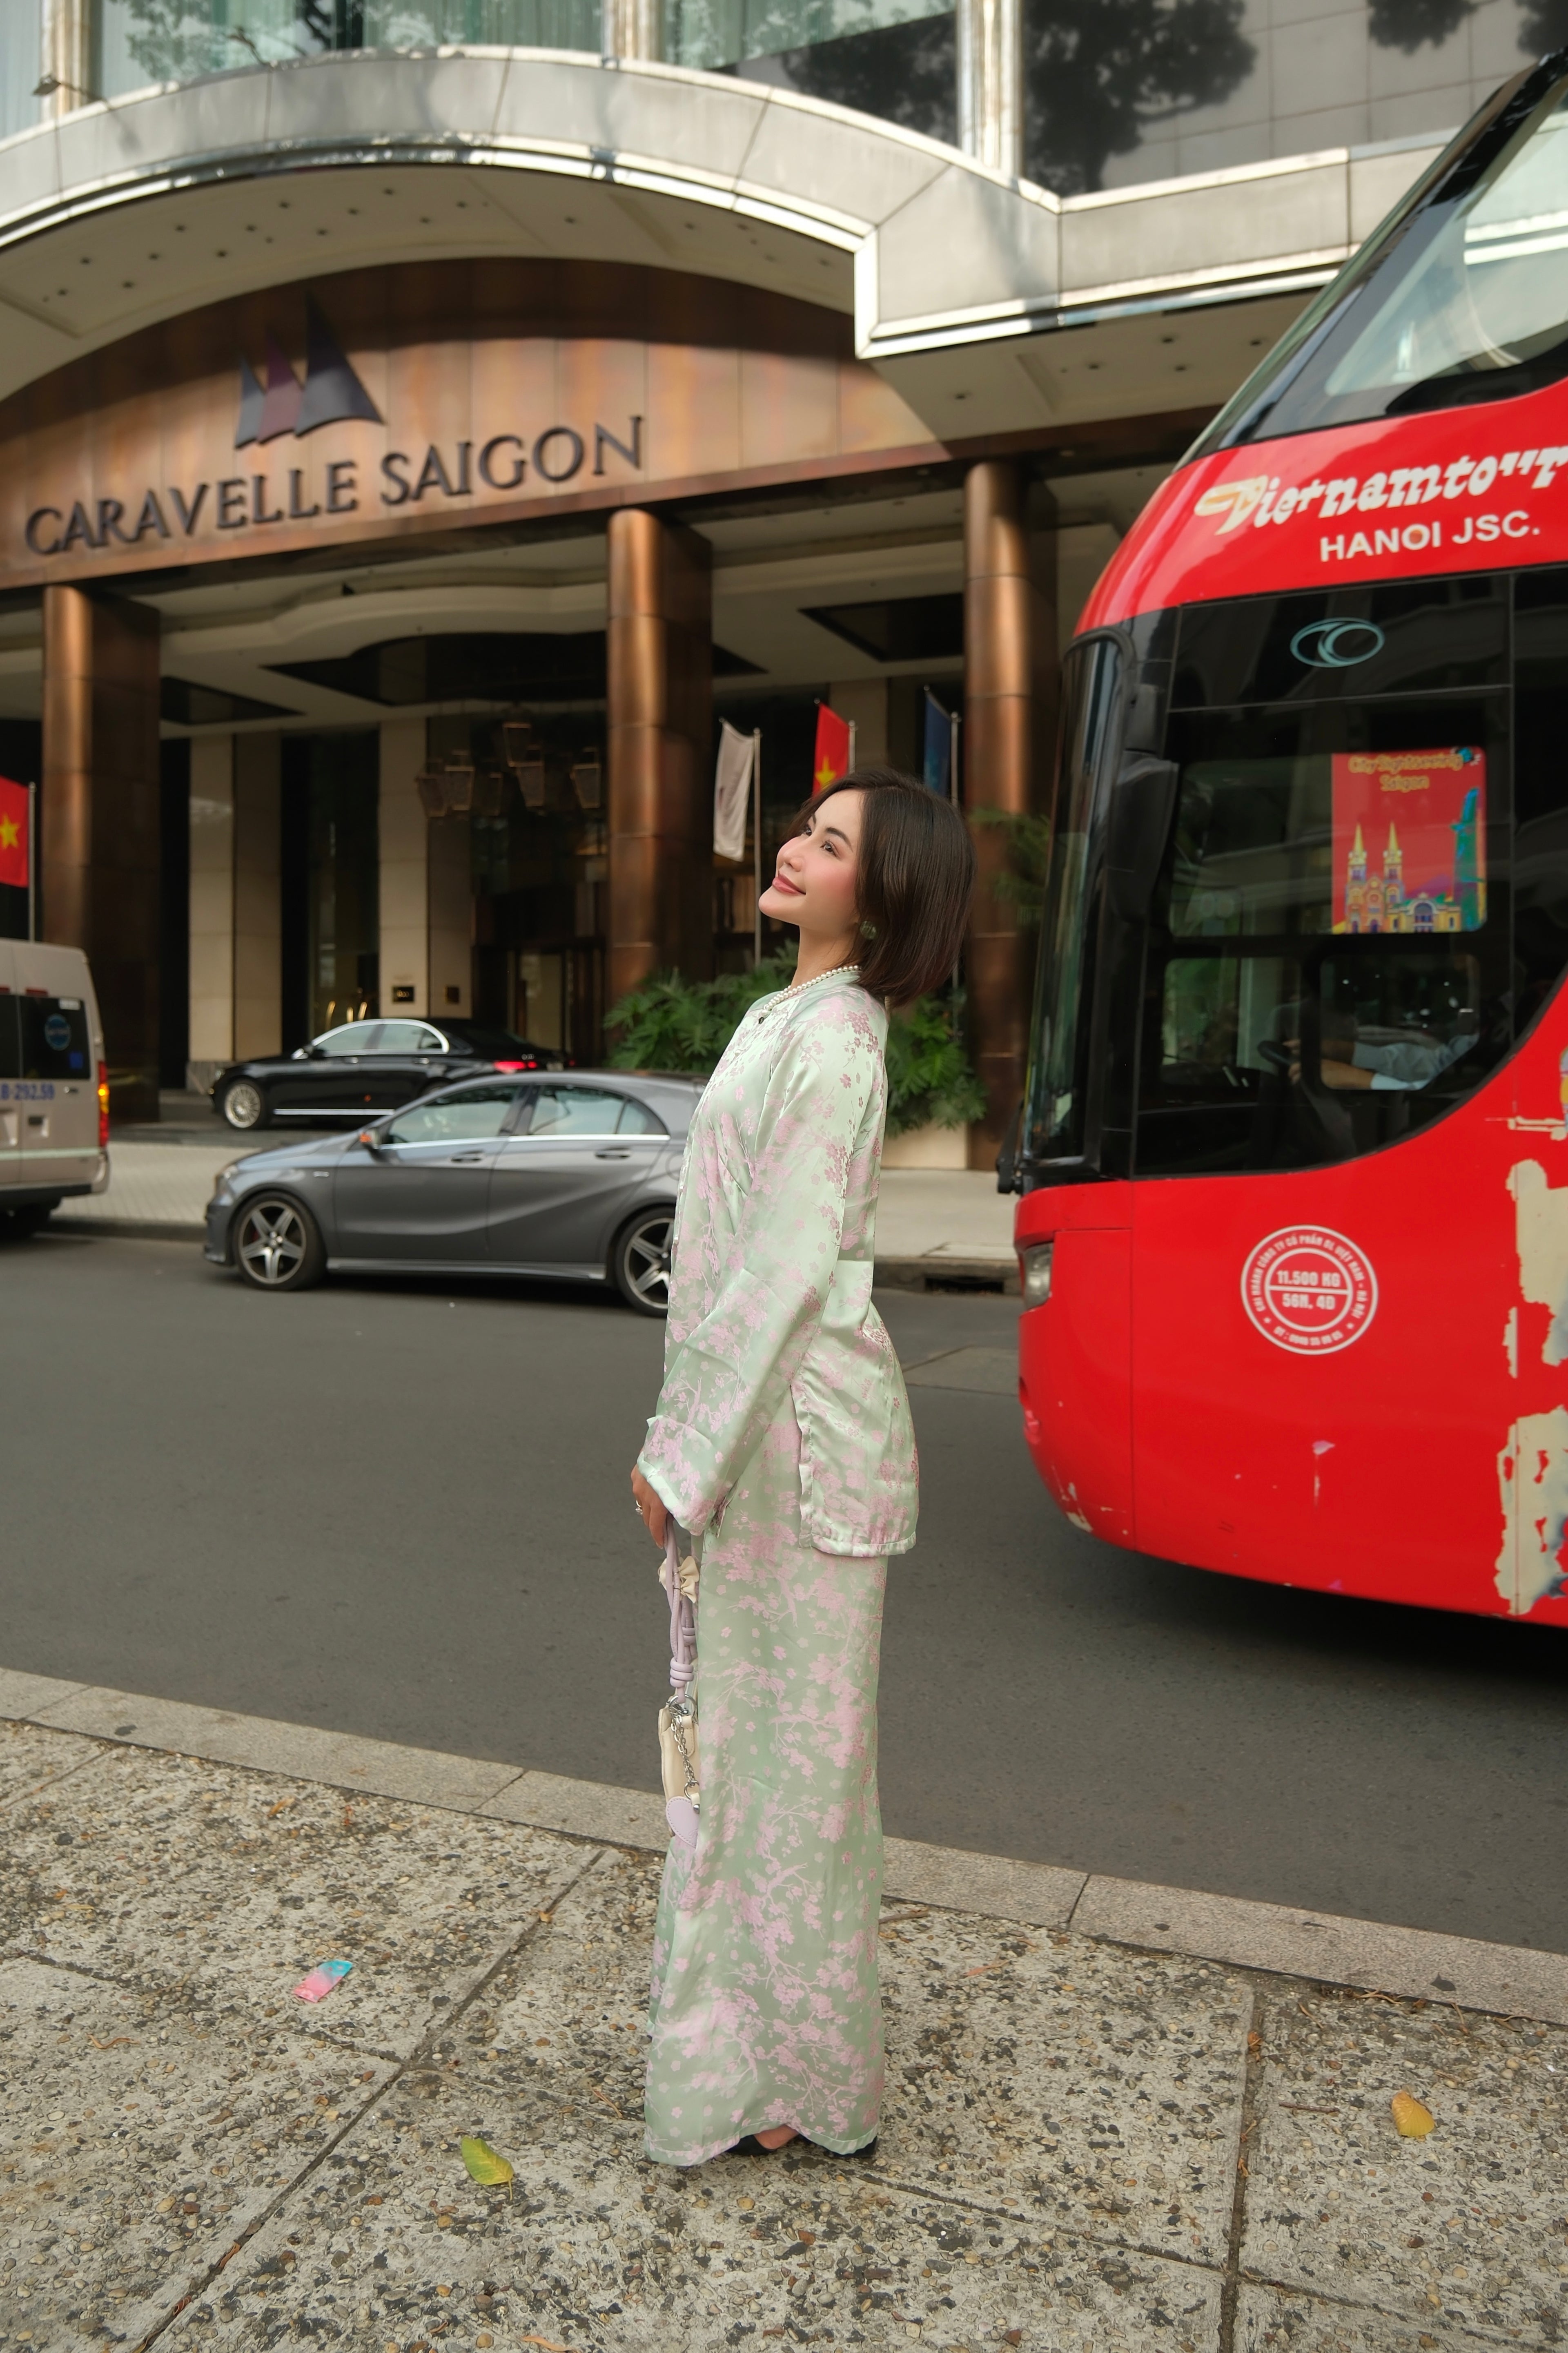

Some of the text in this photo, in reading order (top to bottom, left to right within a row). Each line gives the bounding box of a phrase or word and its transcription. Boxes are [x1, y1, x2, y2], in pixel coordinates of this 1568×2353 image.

[24, 414, 644, 556] CARAVELLE SAIGON
[1320, 510, 1541, 562] HANOI JSC.
[1379, 774, 1429, 793] Saigon
[1276, 1270, 1341, 1287] 11.500 KG
